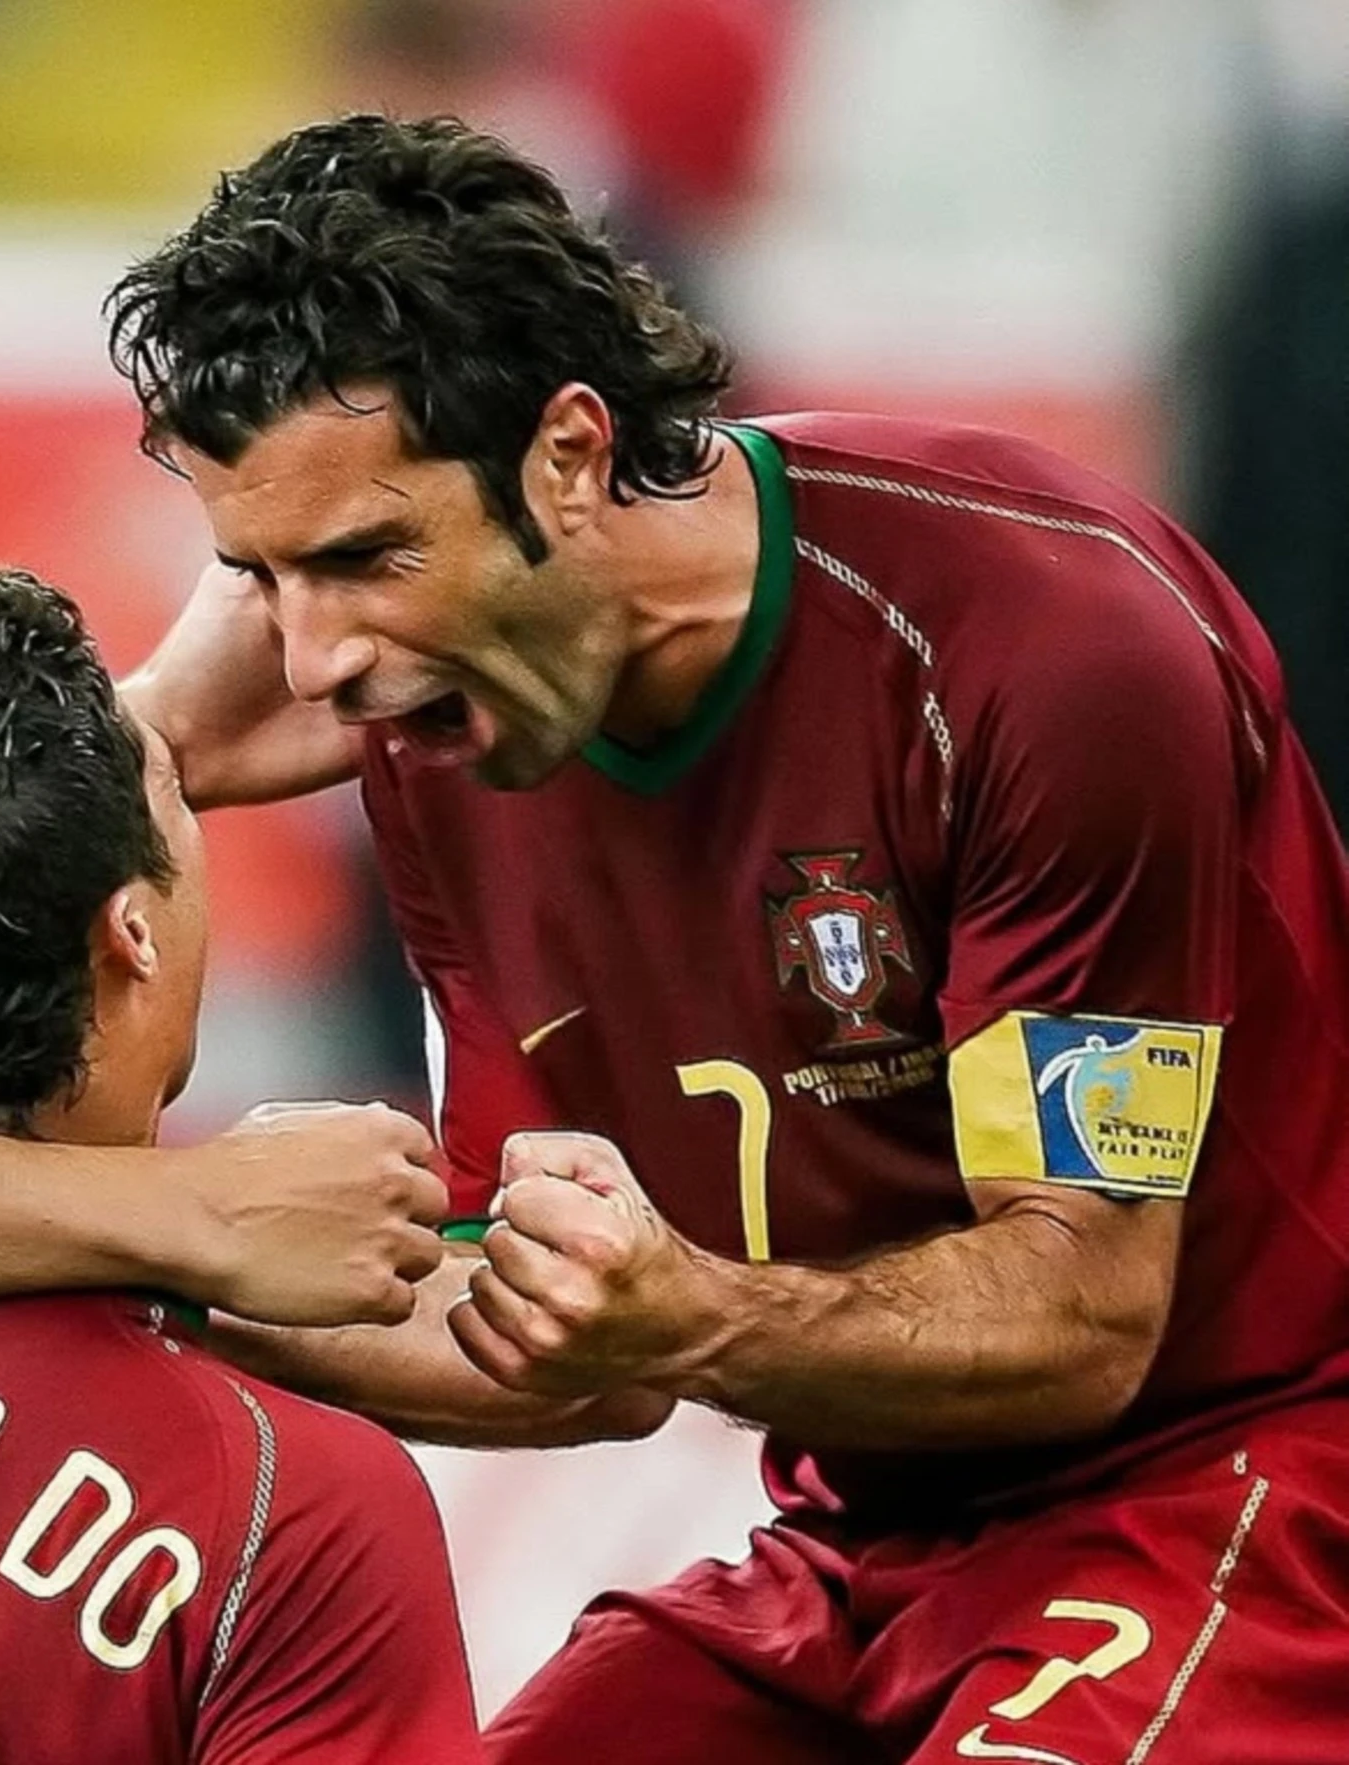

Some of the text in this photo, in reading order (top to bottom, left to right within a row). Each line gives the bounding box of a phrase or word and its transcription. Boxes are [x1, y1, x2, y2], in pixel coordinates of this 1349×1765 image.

[1147, 1046, 1192, 1069] FIFA
[675, 1060, 771, 1261] 7
[1097, 1141, 1186, 1160] FAIR PLAY
[987, 1598, 1152, 1721] 7
